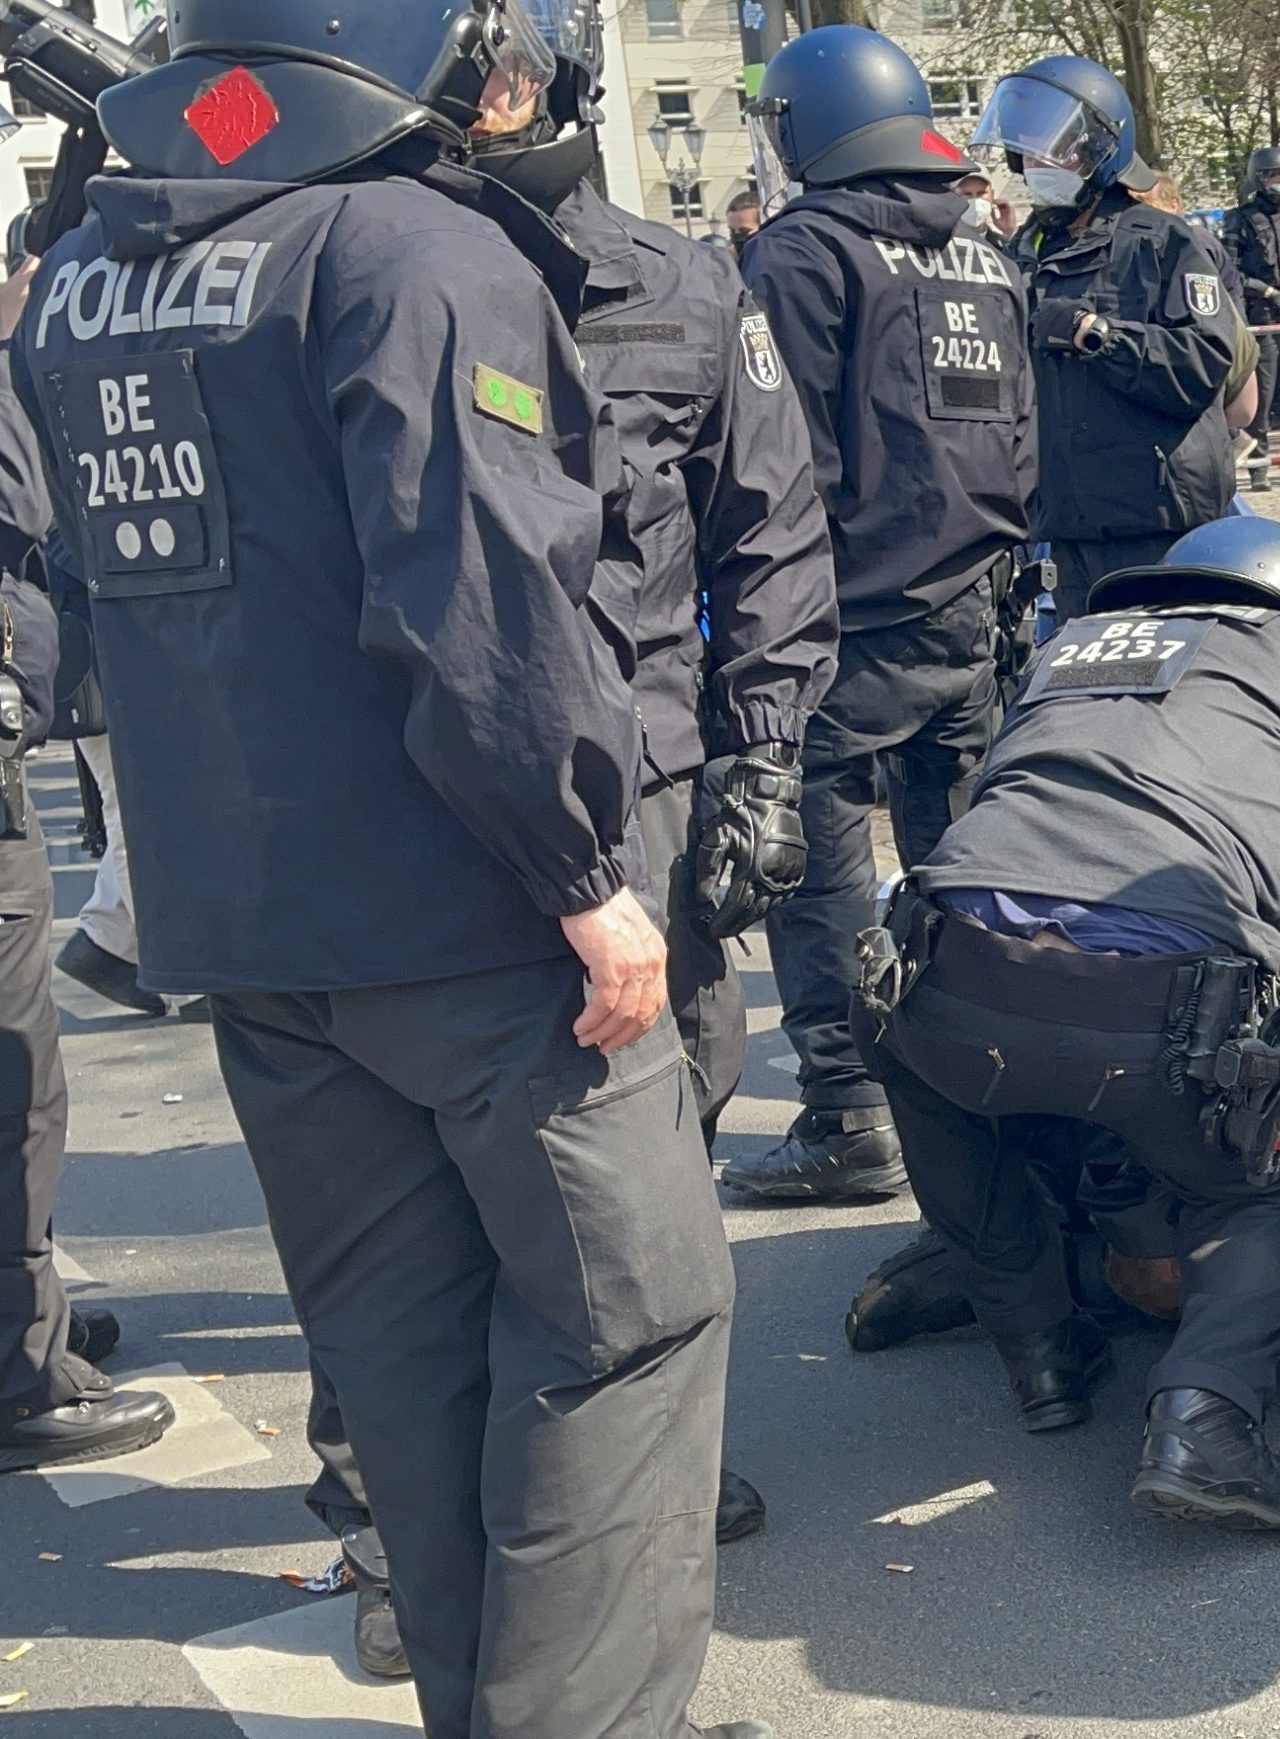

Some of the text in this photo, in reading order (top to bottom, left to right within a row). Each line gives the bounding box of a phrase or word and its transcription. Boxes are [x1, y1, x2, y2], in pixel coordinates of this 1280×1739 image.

[870, 236, 1013, 287] POLIZEI
[33, 241, 273, 349] POLIZEI
[944, 301, 979, 334] BE
[932, 336, 1001, 372] 24224
[99, 373, 155, 436] BE
[78, 440, 205, 507] 24210
[1101, 621, 1164, 640] BE
[1050, 640, 1186, 667] 24237
